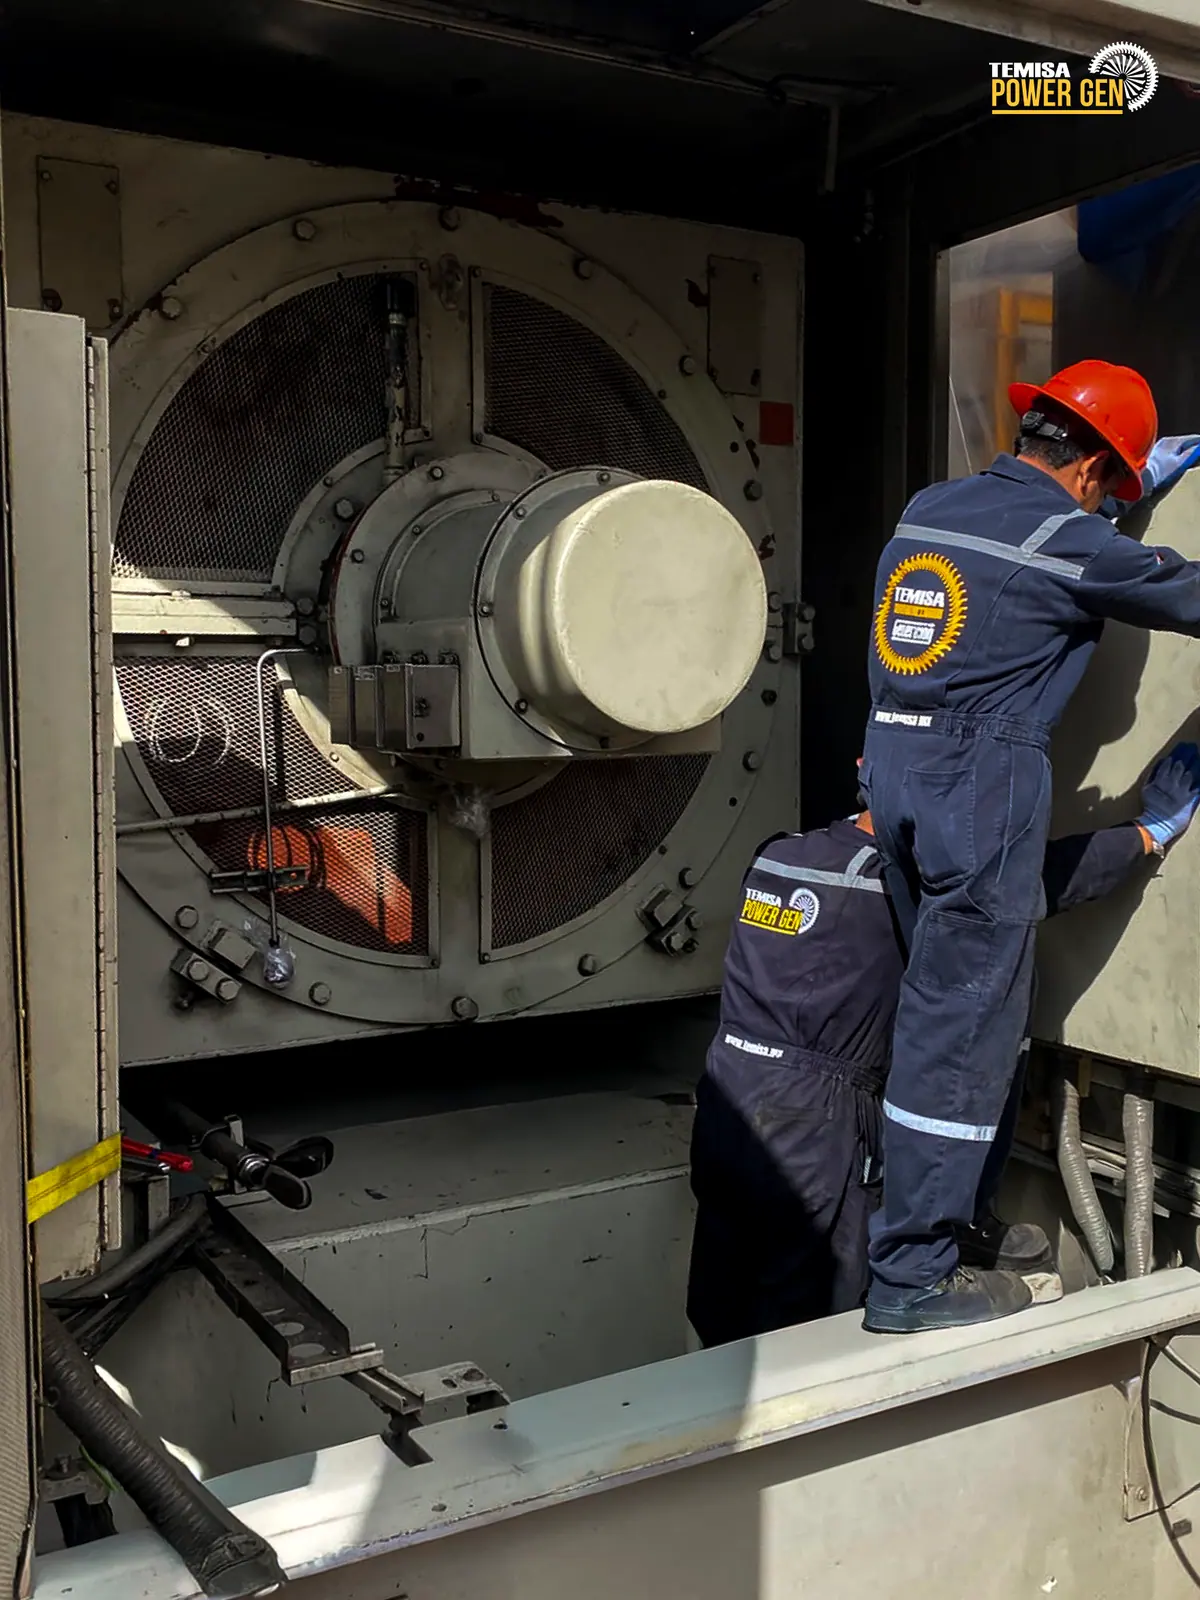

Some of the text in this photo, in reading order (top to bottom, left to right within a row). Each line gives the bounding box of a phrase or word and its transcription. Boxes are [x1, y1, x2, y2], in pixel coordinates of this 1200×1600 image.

[894, 587, 945, 608] TEMISA
[746, 887, 782, 908] TEMISA
[741, 898, 803, 931] POWER GEN
